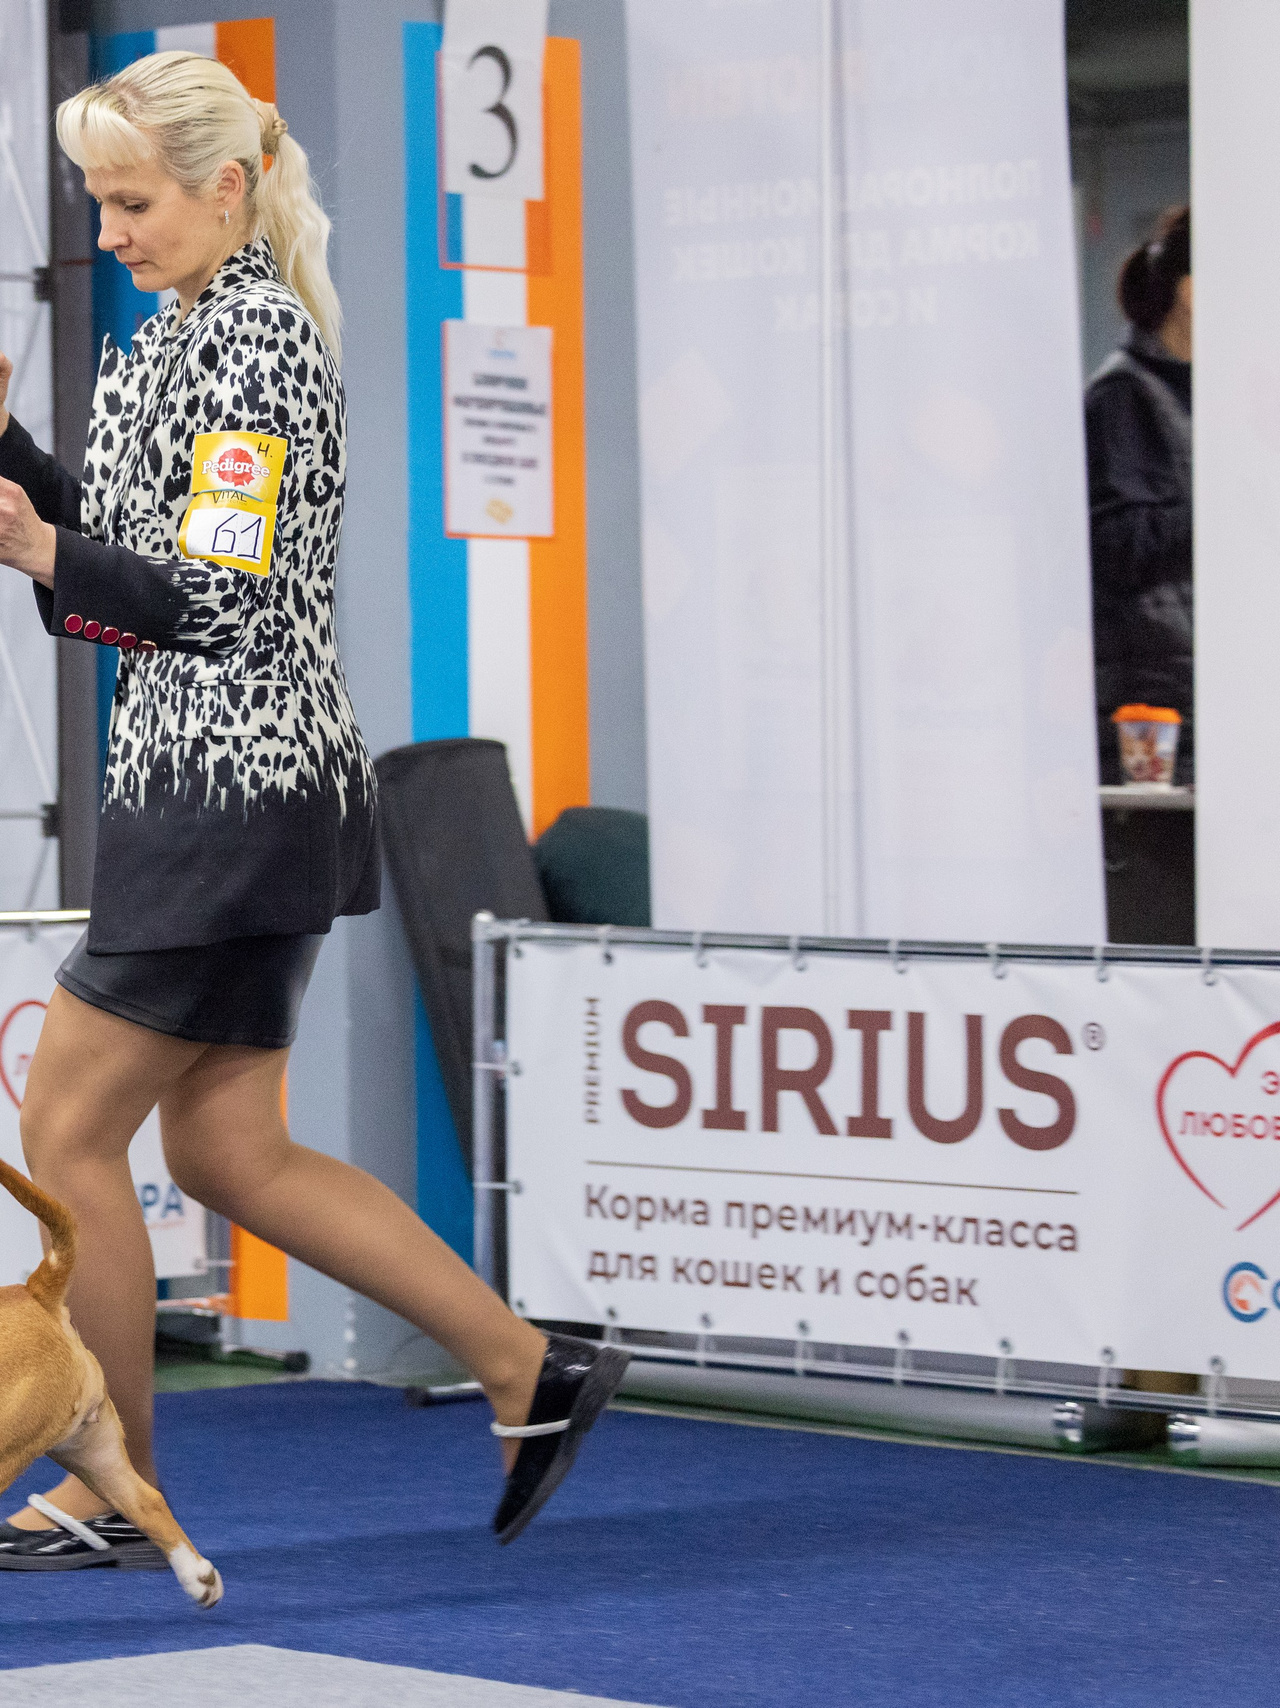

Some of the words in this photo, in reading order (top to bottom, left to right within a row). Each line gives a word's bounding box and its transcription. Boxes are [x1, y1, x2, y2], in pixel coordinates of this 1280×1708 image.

[468, 44, 517, 180] 3
[201, 457, 270, 478] Pedigree
[212, 490, 247, 503] VITAL
[211, 513, 262, 560] 61
[584, 1184, 710, 1230] Корма
[723, 1200, 1079, 1252] премиум-класса
[586, 1249, 658, 1284] для
[671, 1253, 804, 1294] кошек
[818, 1265, 841, 1295] и
[855, 1264, 979, 1306] собак
